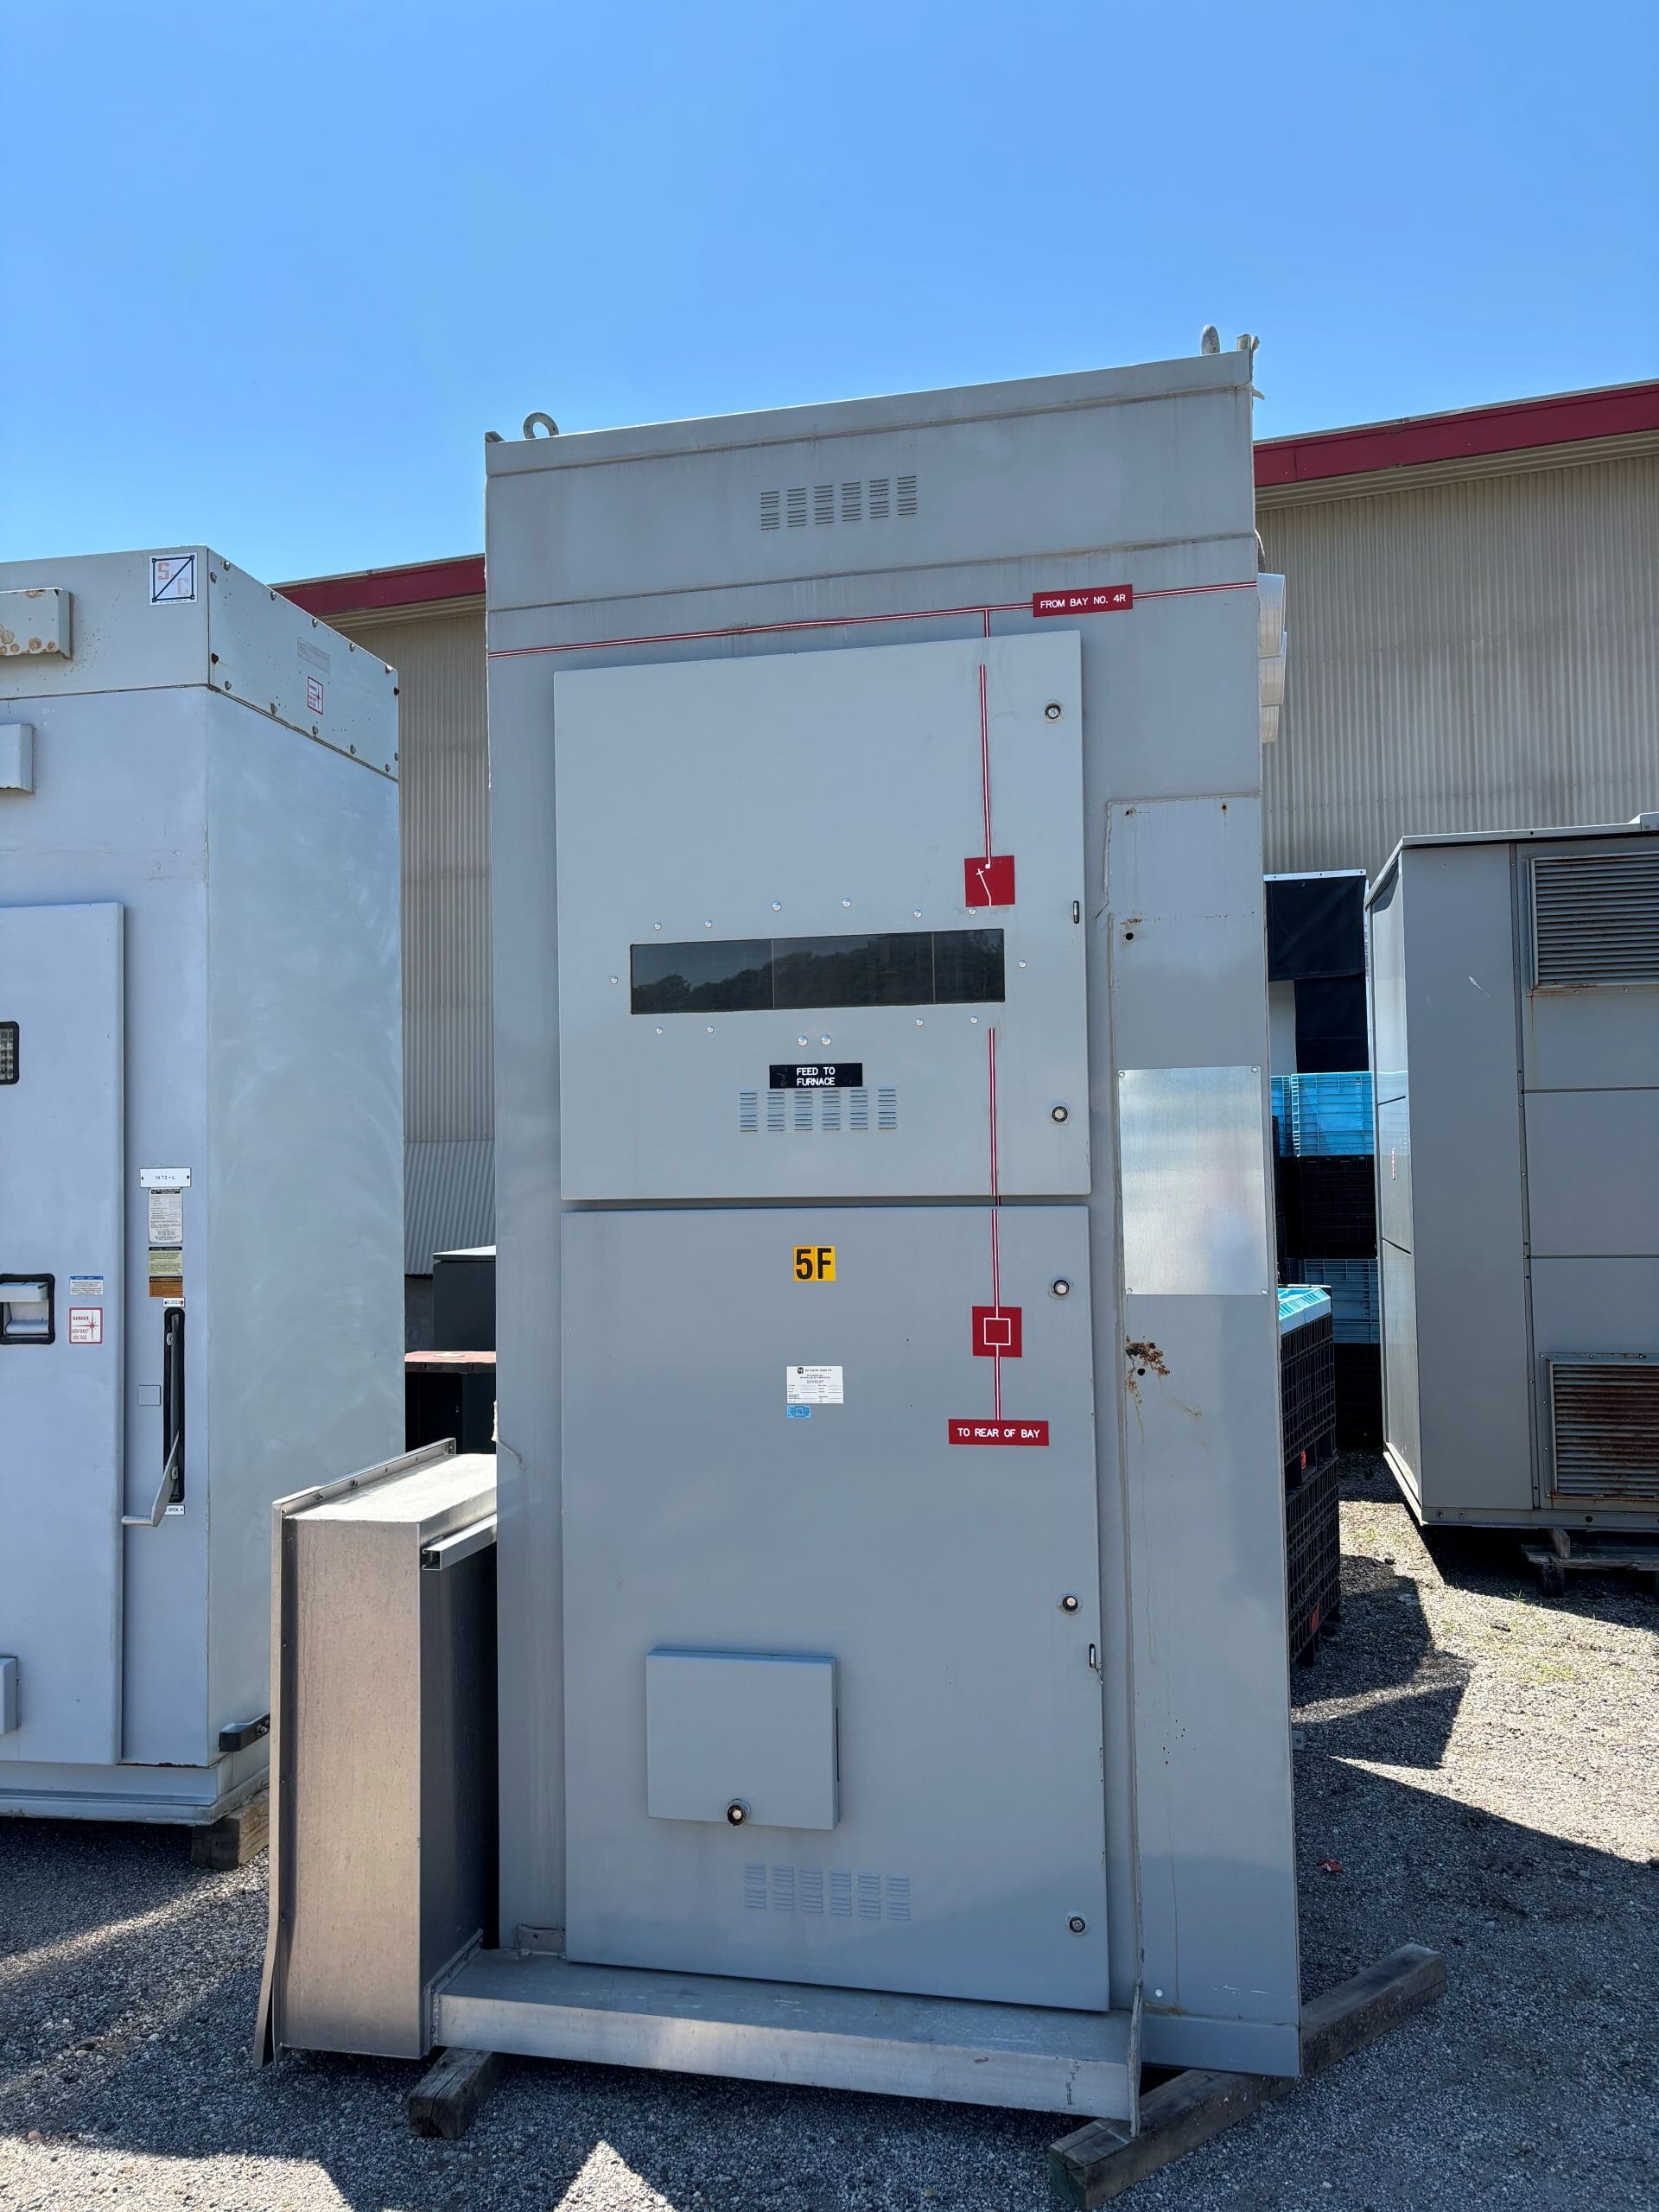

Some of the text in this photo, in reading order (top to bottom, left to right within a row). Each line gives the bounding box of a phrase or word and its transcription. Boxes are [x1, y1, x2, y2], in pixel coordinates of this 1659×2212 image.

[157, 562, 170, 581] S
[1039, 594, 1126, 609] FROM BAY NO. 4R
[796, 1066, 836, 1076] FEED TO
[796, 1077, 836, 1086] FURNACE
[796, 1248, 832, 1280] 5F
[957, 1427, 1040, 1439] TO REAR OF BAY
